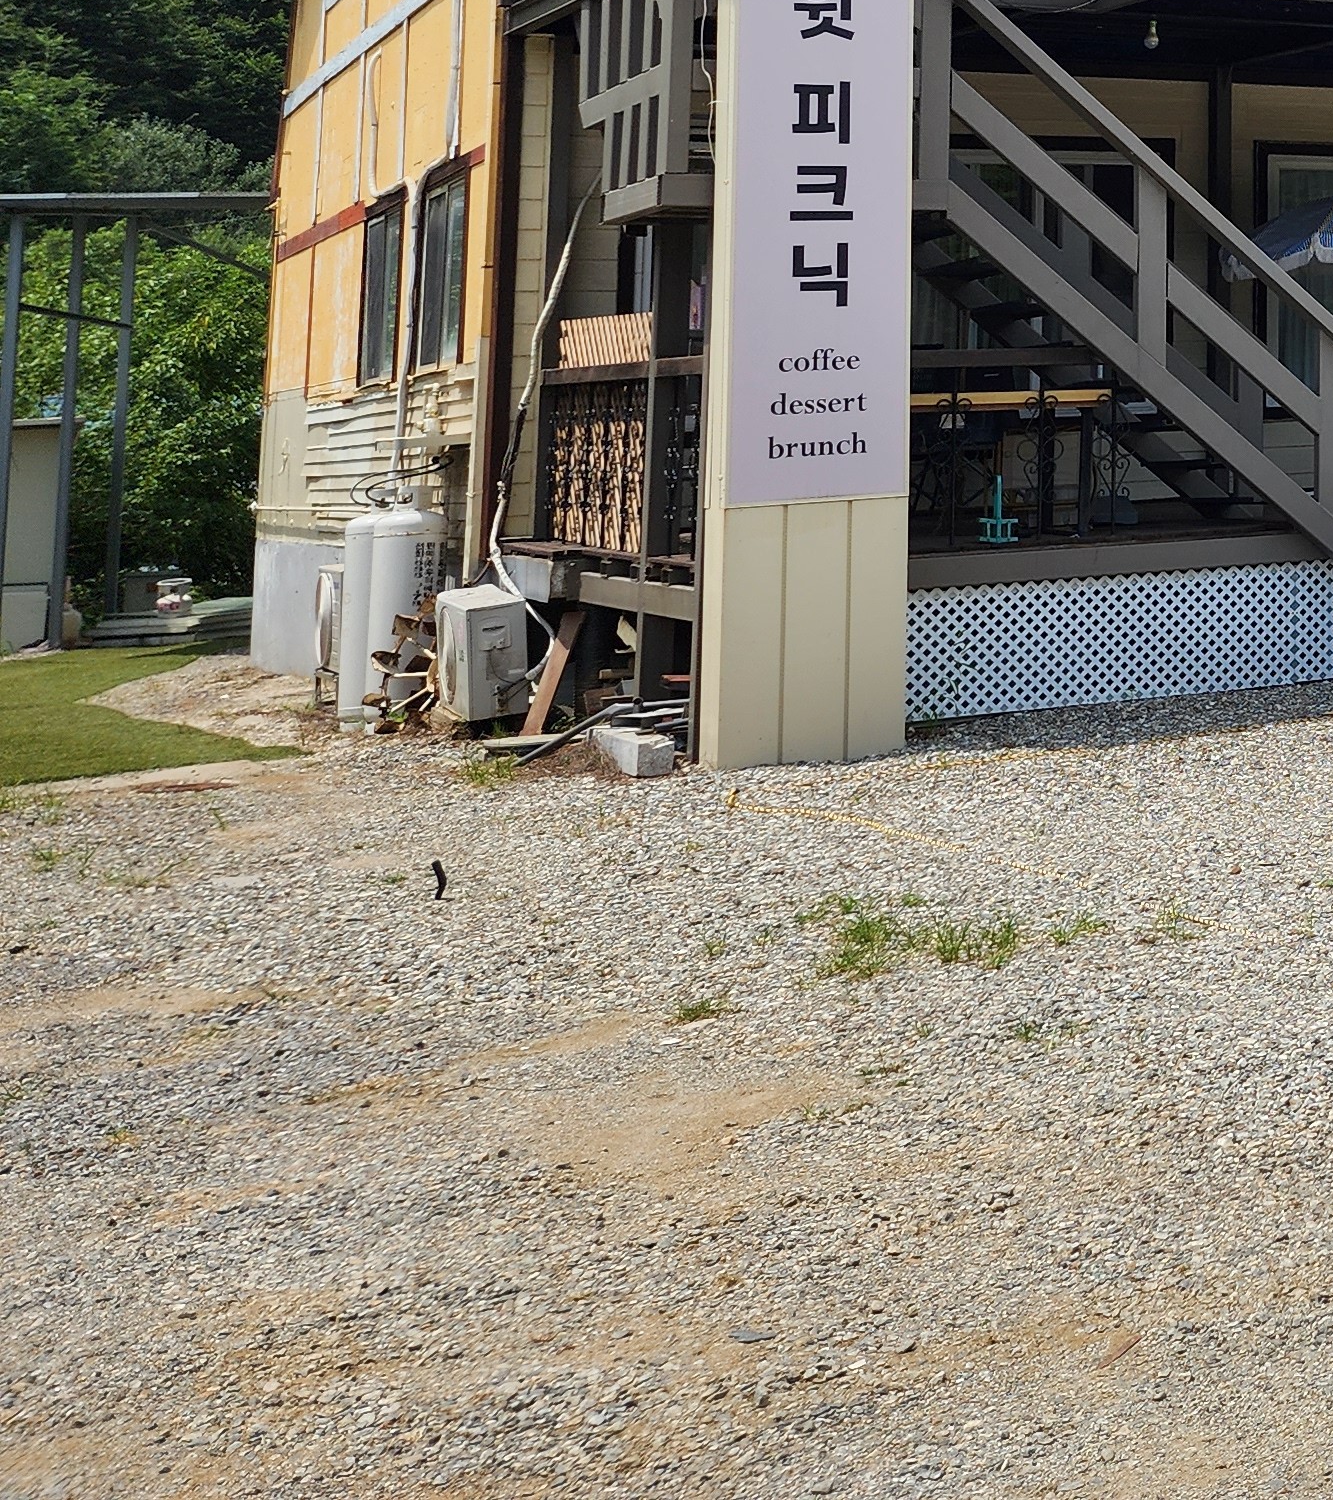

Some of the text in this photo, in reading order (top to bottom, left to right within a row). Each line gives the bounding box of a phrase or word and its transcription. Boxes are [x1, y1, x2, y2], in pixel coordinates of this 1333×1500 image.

[778, 347, 861, 373] coffee
[770, 392, 868, 416] dessert
[768, 431, 868, 460] brunch
